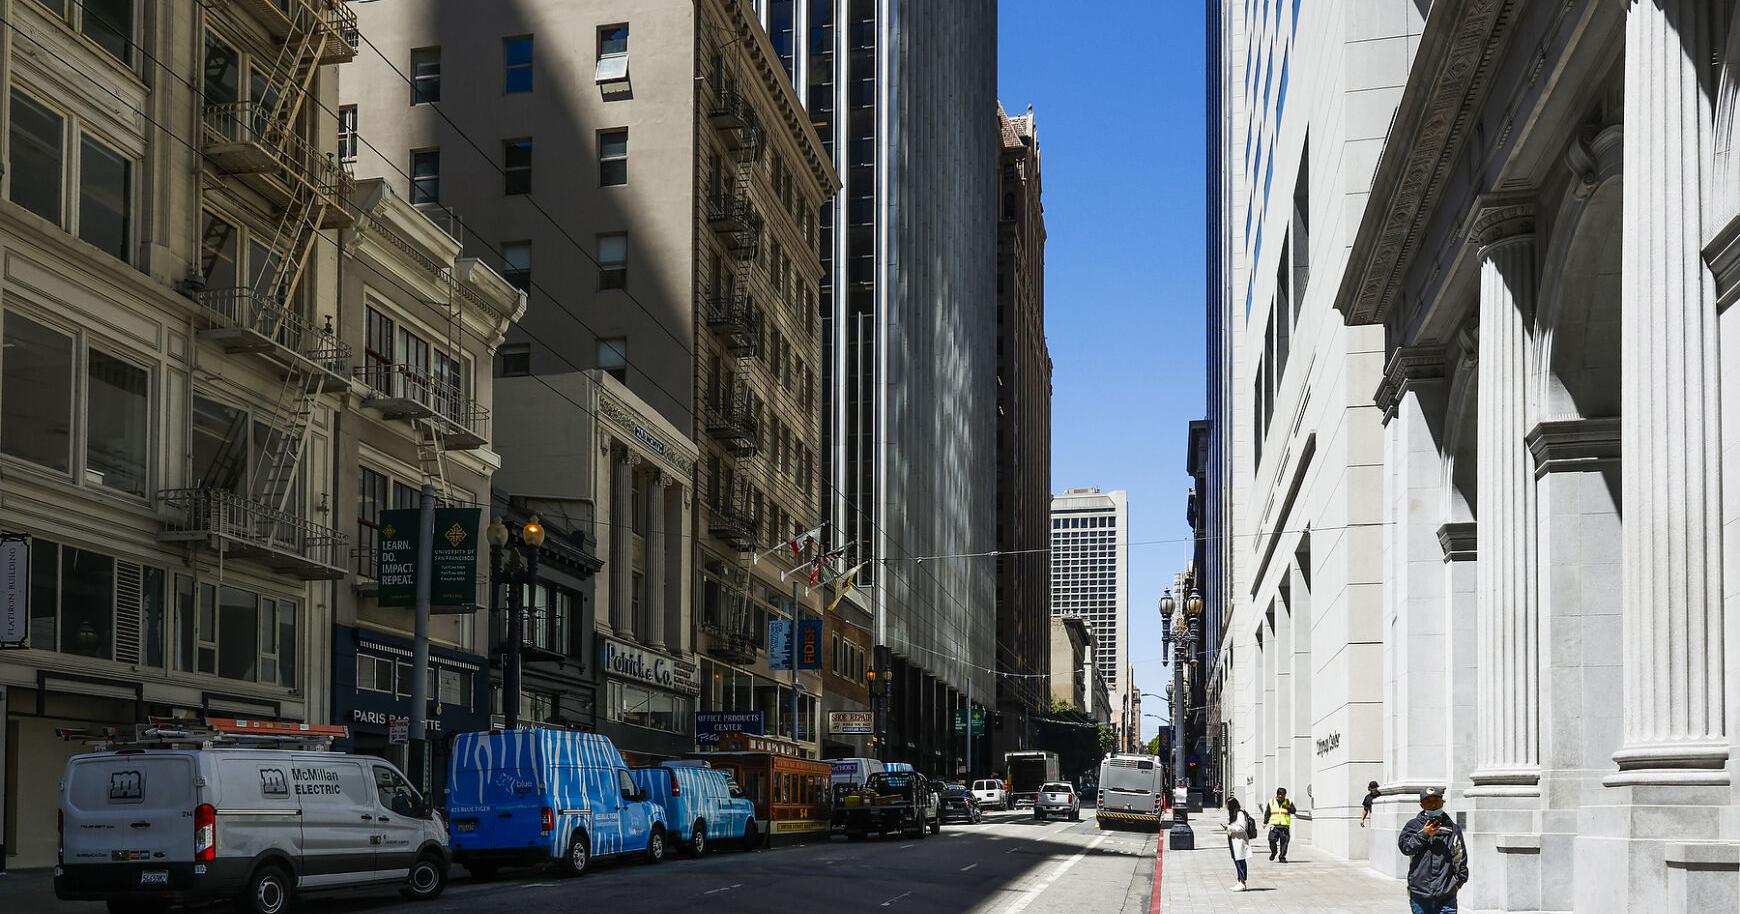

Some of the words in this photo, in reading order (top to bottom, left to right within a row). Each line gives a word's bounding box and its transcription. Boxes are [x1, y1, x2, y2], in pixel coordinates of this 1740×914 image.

[382, 541, 411, 550] LEARN.
[382, 553, 397, 562] DO.
[8, 547, 17, 590] BUILDING
[382, 564, 414, 574] IMPACT.
[382, 575, 414, 585] REPEAT.
[8, 594, 16, 636] FLATIRON
[606, 642, 645, 678] Patrick
[655, 658, 673, 686] Co.
[354, 709, 386, 725] PARIS
[697, 714, 721, 722] OFFICE
[723, 713, 760, 722] PRODUCTS
[832, 713, 848, 721] SHOE
[850, 713, 872, 721] REPAIR
[714, 723, 742, 731] CENTER
[291, 768, 339, 782] McMillan
[516, 779, 533, 788] blue
[295, 784, 341, 795] ELECTRIC
